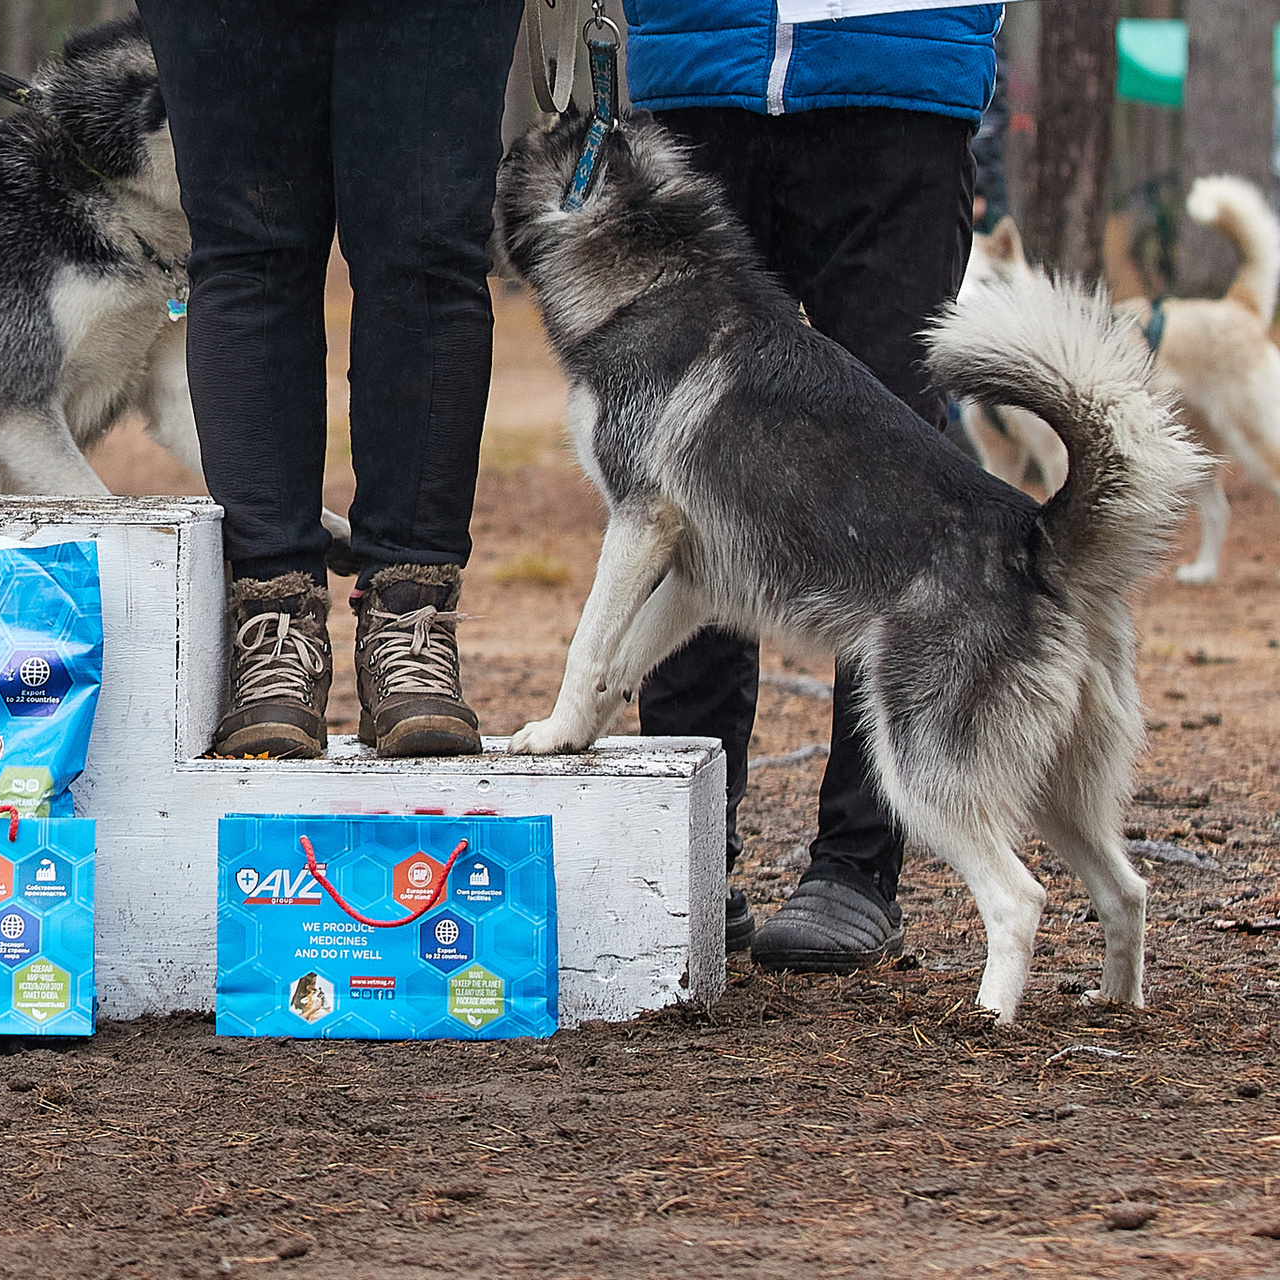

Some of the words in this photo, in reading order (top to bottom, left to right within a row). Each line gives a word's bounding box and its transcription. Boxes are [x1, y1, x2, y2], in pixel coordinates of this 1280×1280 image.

[21, 689, 46, 698] Export
[26, 696, 60, 704] countries
[470, 889, 503, 897] production
[270, 897, 294, 905] group
[302, 922, 320, 932] WE
[323, 922, 375, 933] PRODUCE
[309, 935, 368, 946] MEDICINES
[294, 949, 319, 959] AND
[321, 949, 338, 959] DO
[339, 949, 352, 959] IT
[352, 949, 383, 960] WELL
[436, 947, 457, 955] Export
[468, 970, 484, 979] WANT
[471, 979, 482, 988] THE
[482, 979, 502, 988] PLANET
[485, 988, 497, 996] THIS
